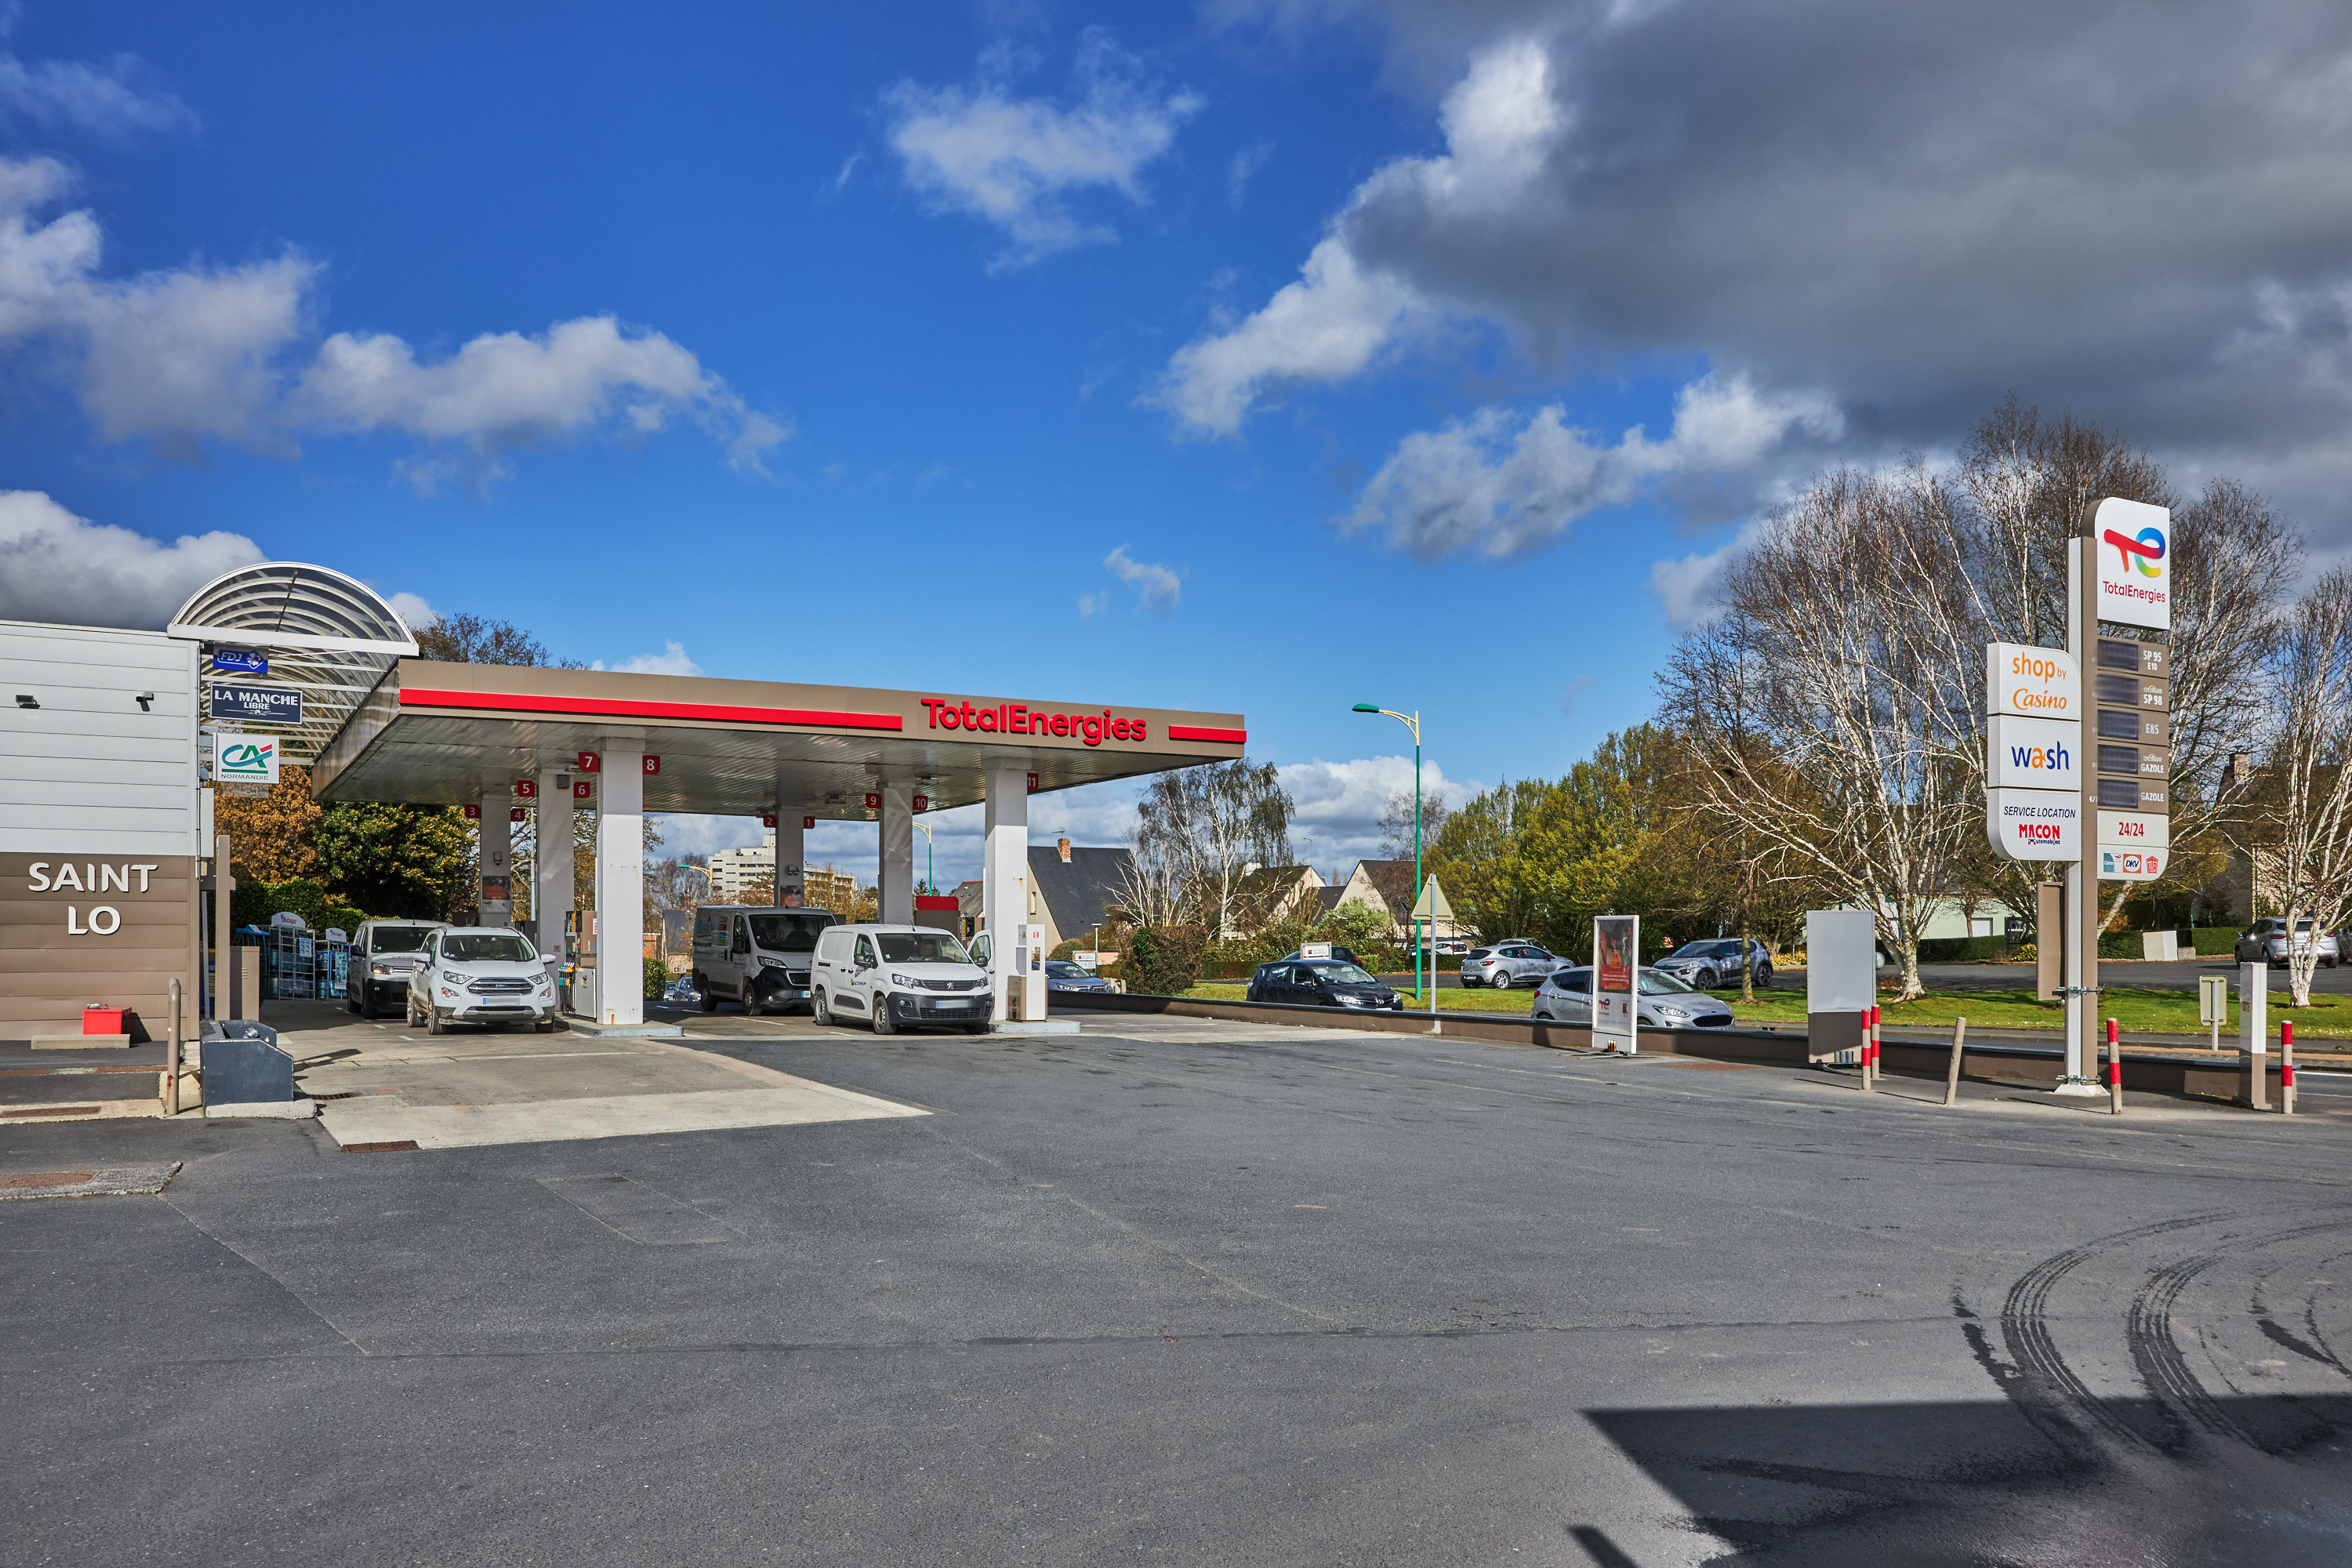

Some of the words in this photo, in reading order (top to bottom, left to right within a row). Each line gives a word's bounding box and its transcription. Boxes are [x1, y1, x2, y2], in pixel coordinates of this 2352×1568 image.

[2103, 580, 2165, 604] TotalEnergies
[220, 652, 242, 662] FDJ
[2143, 649, 2152, 661] SP
[2153, 651, 2161, 662] 95
[2013, 651, 2055, 684] shop
[2057, 666, 2067, 680] by
[2147, 662, 2158, 671] E10
[214, 689, 234, 701] LA
[238, 691, 299, 706] MANCHE
[2013, 688, 2067, 710] Casino
[2143, 694, 2153, 705] SP
[2153, 695, 2162, 706] 98
[243, 702, 270, 710] LIBRE
[920, 697, 1147, 746] TotalEnergies
[2145, 723, 2159, 735] E85
[2011, 740, 2069, 770] wash
[585, 756, 593, 768] 7
[647, 759, 655, 771] 8
[2140, 763, 2165, 774] GAZOLE
[522, 783, 530, 793] 5
[1027, 776, 1036, 788] 11
[578, 786, 586, 795] 6
[870, 796, 877, 806] 9
[916, 798, 926, 808] 10
[2140, 792, 2165, 802] GAZOLE
[470, 807, 475, 816] 3
[514, 811, 521, 819] 4
[2003, 806, 2036, 816] SERVICE
[2037, 808, 2076, 818] LOCATION
[767, 817, 772, 826] 2
[2018, 823, 2060, 839] MACON
[2118, 822, 2144, 837] 24/24
[28, 862, 158, 893] SAINT
[68, 906, 122, 935] LO
[283, 916, 297, 924] Butagaz
